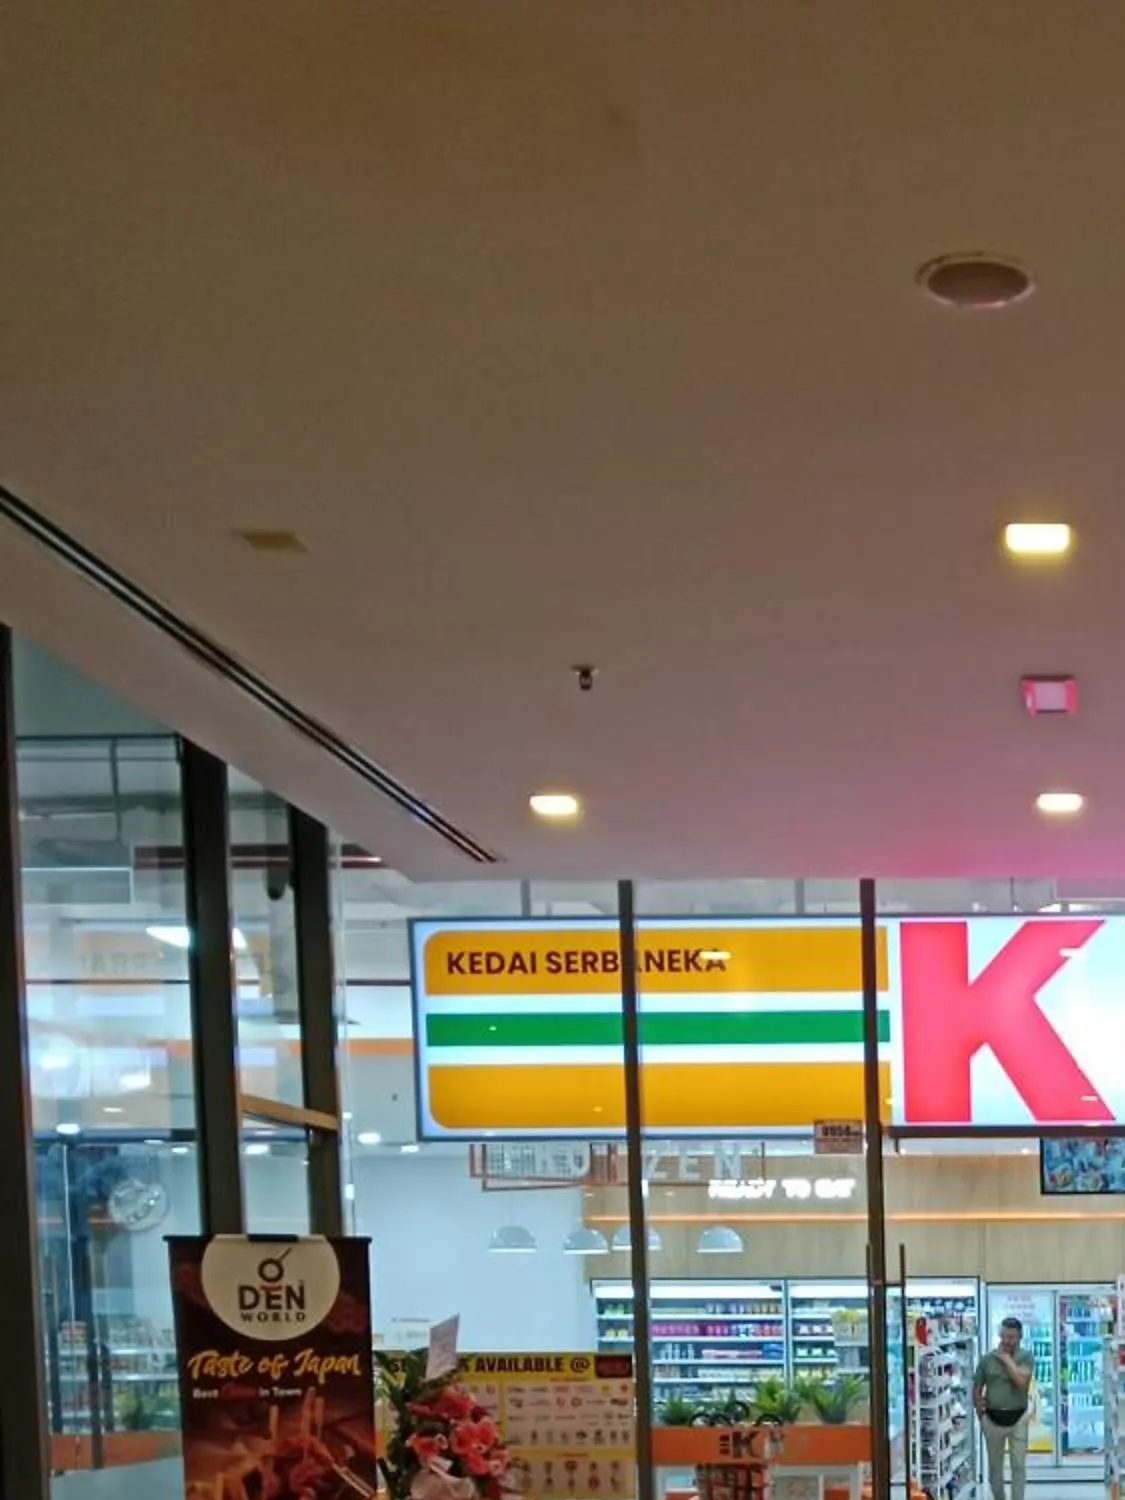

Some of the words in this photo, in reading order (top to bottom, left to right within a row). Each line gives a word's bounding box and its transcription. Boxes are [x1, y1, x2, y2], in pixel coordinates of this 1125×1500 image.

[447, 951, 537, 975] KEDAI
[546, 949, 727, 974] SERBNEKA
[240, 1311, 306, 1322] WORLD
[187, 1351, 254, 1379] Taste
[257, 1354, 290, 1380] of
[294, 1348, 362, 1384] Japan
[475, 1357, 564, 1373] AVAILABLE
[570, 1356, 591, 1373] @
